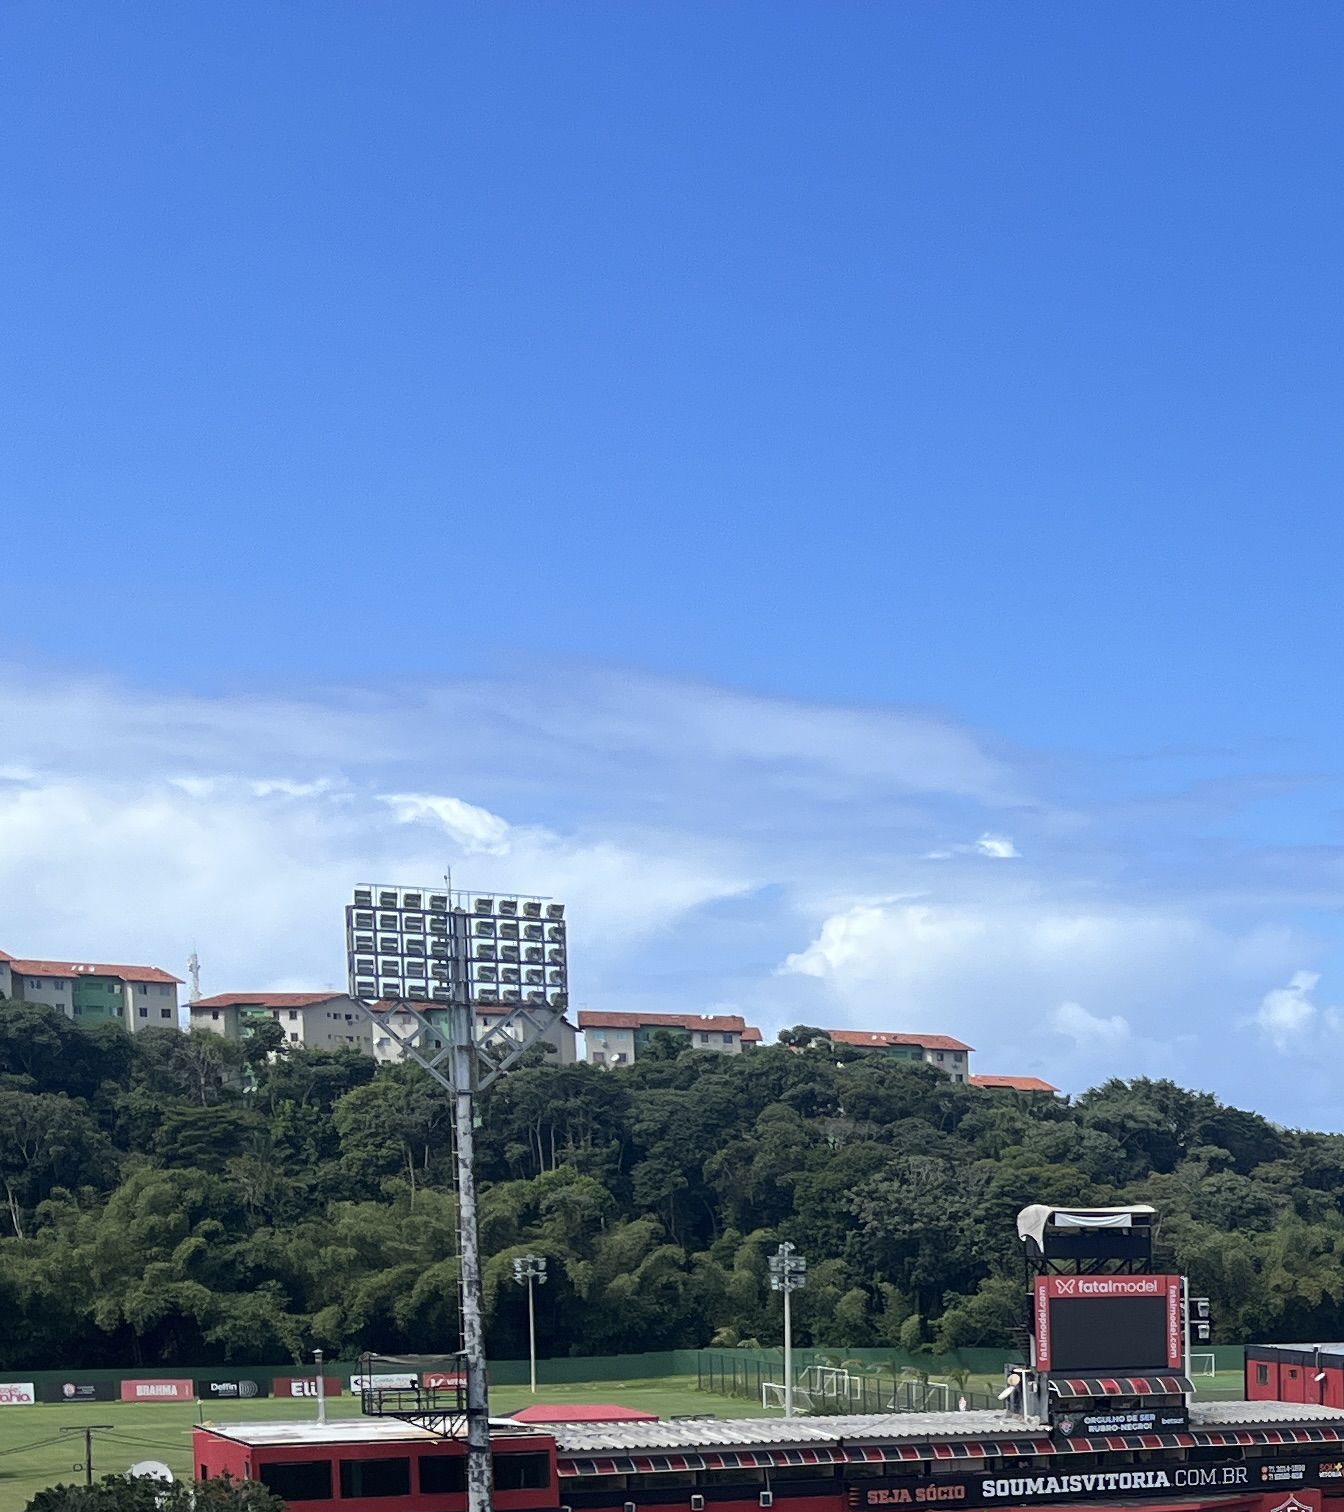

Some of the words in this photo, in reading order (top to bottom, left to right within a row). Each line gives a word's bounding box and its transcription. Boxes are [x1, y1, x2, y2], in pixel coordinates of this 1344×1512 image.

[1078, 1280, 1158, 1293] fatalmodel
[1038, 1286, 1048, 1361] fatalmodel.com
[1168, 1285, 1178, 1358] fatalmodel.com
[136, 1384, 178, 1397] BRAHMA
[867, 1489, 912, 1505] SEJA
[916, 1483, 966, 1501] SÓCIO
[982, 1467, 1249, 1498] SOUMAISVITORIA.COM.BR
